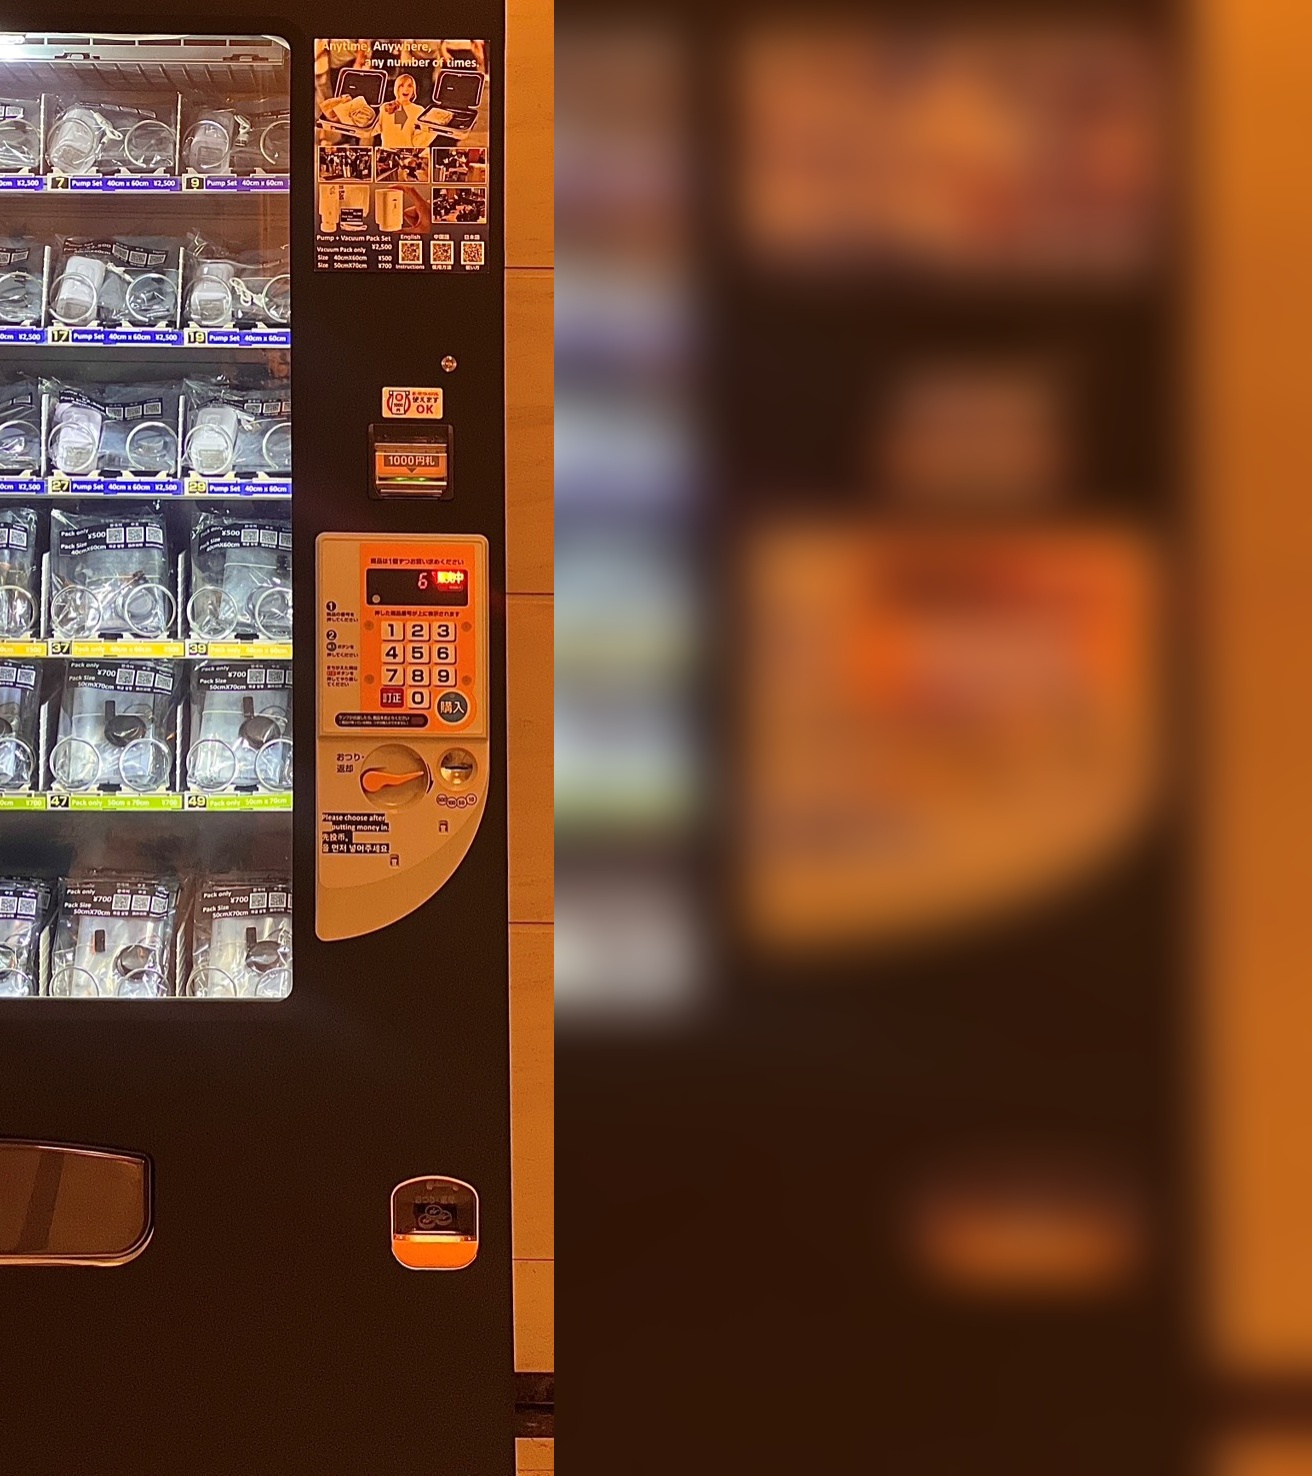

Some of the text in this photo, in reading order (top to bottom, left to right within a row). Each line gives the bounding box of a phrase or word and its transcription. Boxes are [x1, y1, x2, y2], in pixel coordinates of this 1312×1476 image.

[322, 41, 431, 52] Anytime, Anywhere,
[365, 58, 480, 68] any number of times.
[55, 178, 65, 188] 7
[72, 180, 90, 188] Pump
[153, 180, 175, 188] ¥2,500
[190, 178, 200, 188] 9
[52, 330, 69, 342] 17
[73, 333, 92, 341] Pump
[156, 333, 177, 341] ¥2,500
[189, 331, 206, 343] 19
[416, 404, 434, 414] OK
[389, 455, 435, 466] 1000円札
[52, 481, 69, 491] 27
[189, 482, 206, 493] 29
[418, 572, 428, 589] 6
[388, 624, 394, 637] 1
[412, 624, 424, 637] 2
[437, 624, 449, 637] 3
[52, 643, 69, 654] 37
[189, 643, 207, 655] 39
[385, 646, 398, 659] 4
[412, 646, 424, 659] 5
[437, 647, 449, 660] 6
[386, 669, 398, 682] 7
[412, 669, 424, 682] 8
[438, 670, 449, 682] 9
[382, 693, 402, 703] 訂正
[412, 691, 424, 705] 0
[440, 701, 465, 714] 購入
[337, 764, 354, 773] 返却
[51, 796, 68, 807] 47
[189, 796, 206, 807] 49
[331, 844, 347, 852] 먼저
